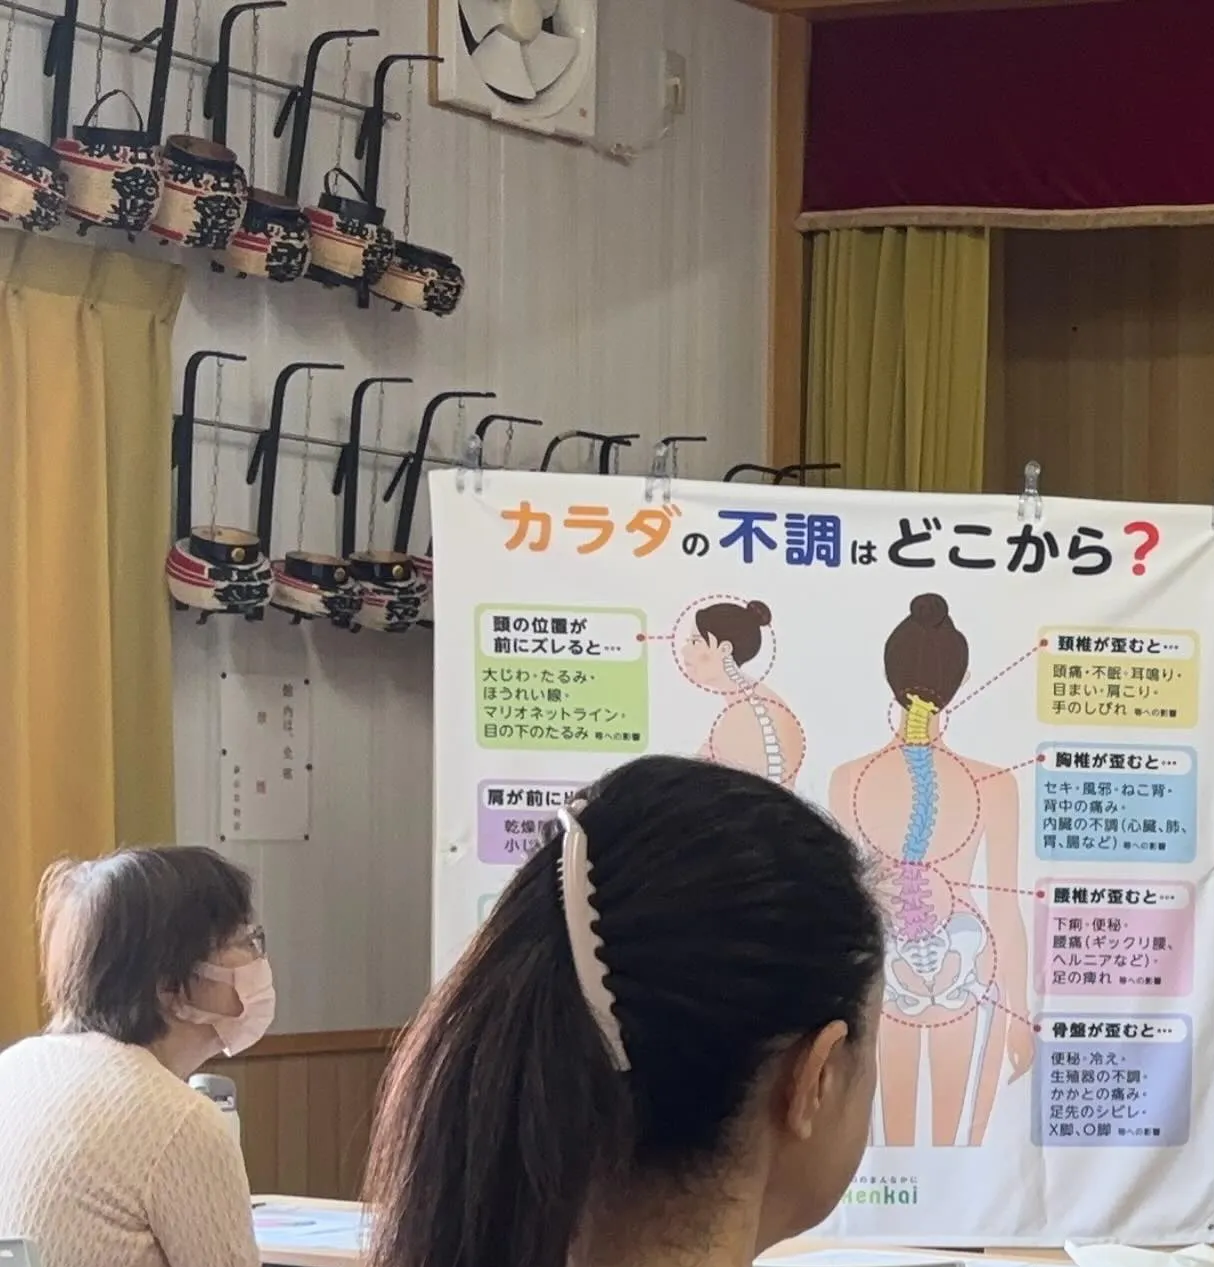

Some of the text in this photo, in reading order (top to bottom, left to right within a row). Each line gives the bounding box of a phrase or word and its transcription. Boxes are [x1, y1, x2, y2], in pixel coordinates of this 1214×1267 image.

[493, 615, 588, 635] 頭の位置が
[482, 667, 596, 684] 大じわ・たるみ・
[1052, 663, 1182, 682] 頭痛・不眠・耳鳴り・
[483, 686, 570, 702] ほうれい線・
[1053, 682, 1159, 698] 目まい・肩こり・
[483, 706, 627, 723] マリオネットライン・
[1052, 701, 1127, 716] 手のしびれ
[483, 723, 589, 741] 目の下のたるみ
[1044, 781, 1173, 798] セキ・風邪・ねこ背・
[1044, 799, 1126, 814] 背中の痛み・
[504, 819, 544, 834] 乾燥
[1050, 1069, 1149, 1084] 生殖器の不調・
[1050, 1087, 1148, 1101] かかとの痛み・
[1049, 1104, 1148, 1120] 足先のシビレ・
